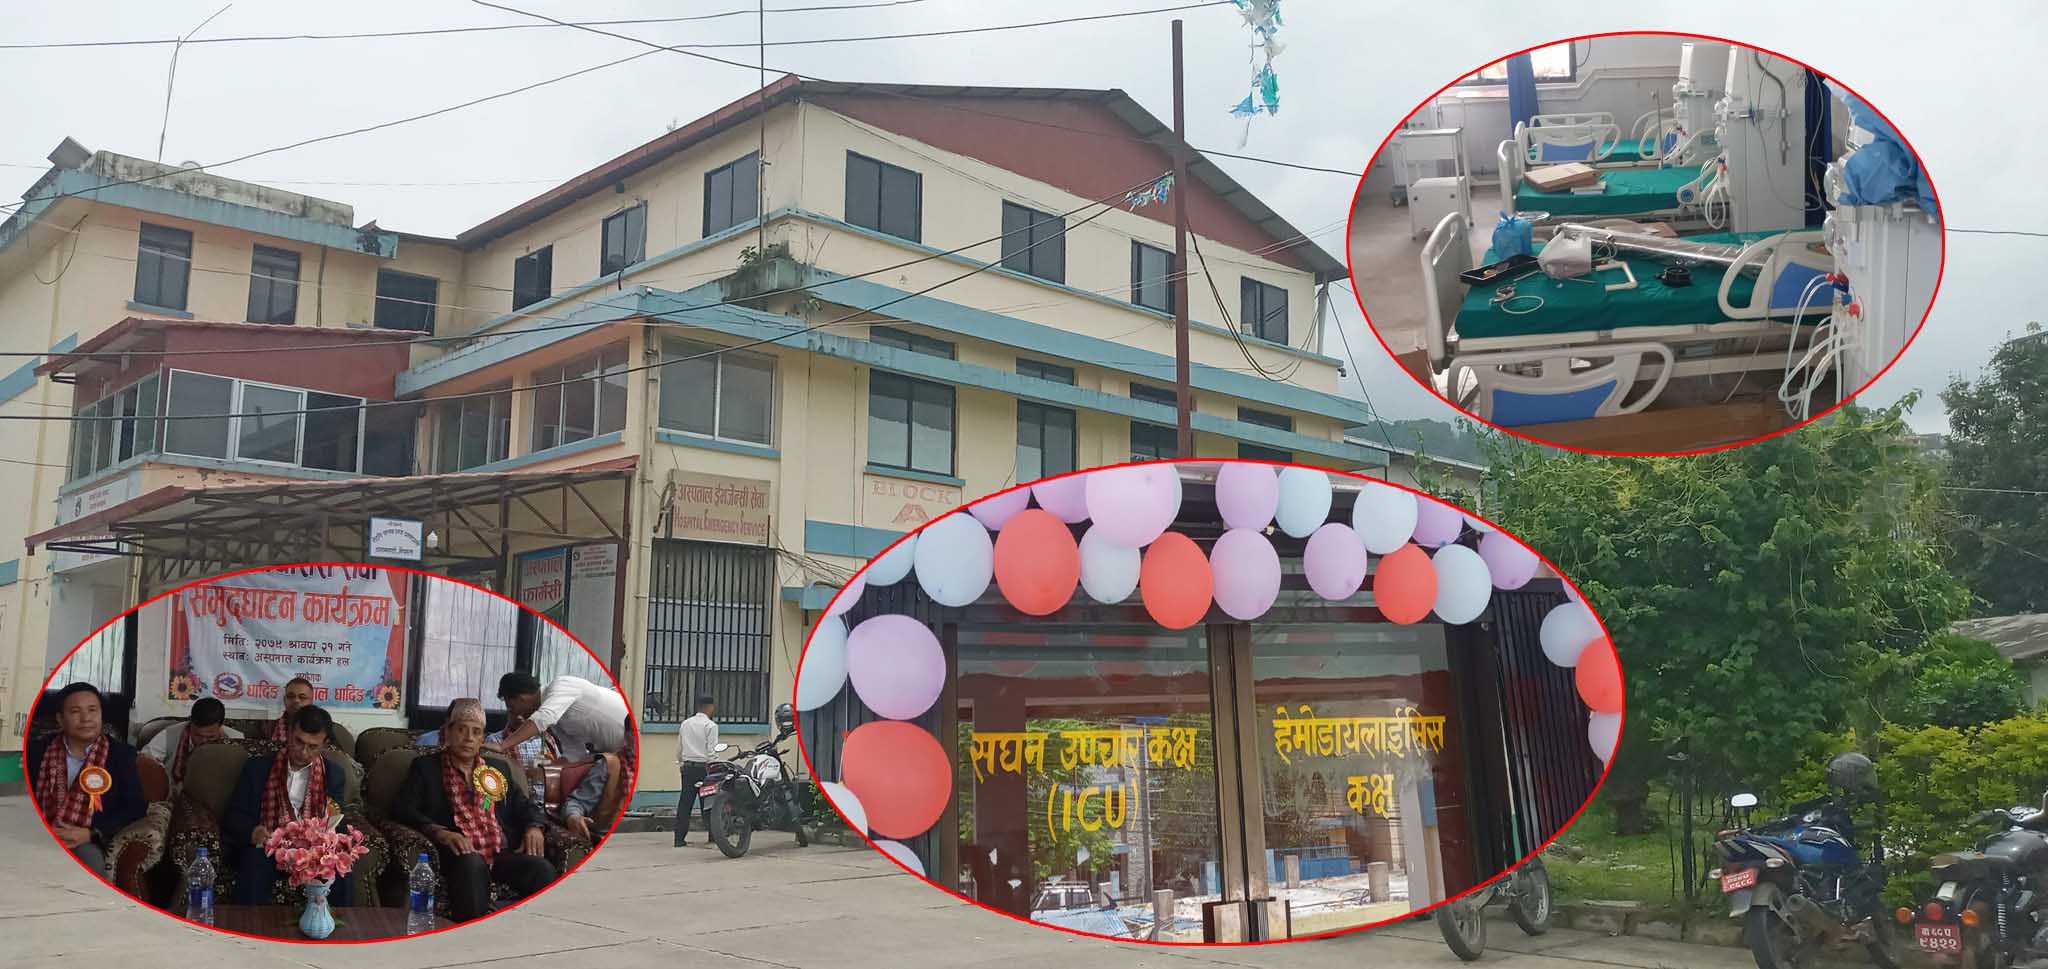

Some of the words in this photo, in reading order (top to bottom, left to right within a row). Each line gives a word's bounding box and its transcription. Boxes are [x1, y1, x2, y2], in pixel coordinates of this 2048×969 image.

[677, 484, 713, 505] अस्पताल
[872, 480, 952, 504] BLOCK
[303, 585, 392, 627] कार्यक्रम
[321, 641, 333, 653] २१
[1060, 729, 1144, 776] उपचार
[1148, 727, 1198, 771] कक्ष
[1048, 778, 1139, 843] (ICU)
[1346, 774, 1395, 819] कक्ष
